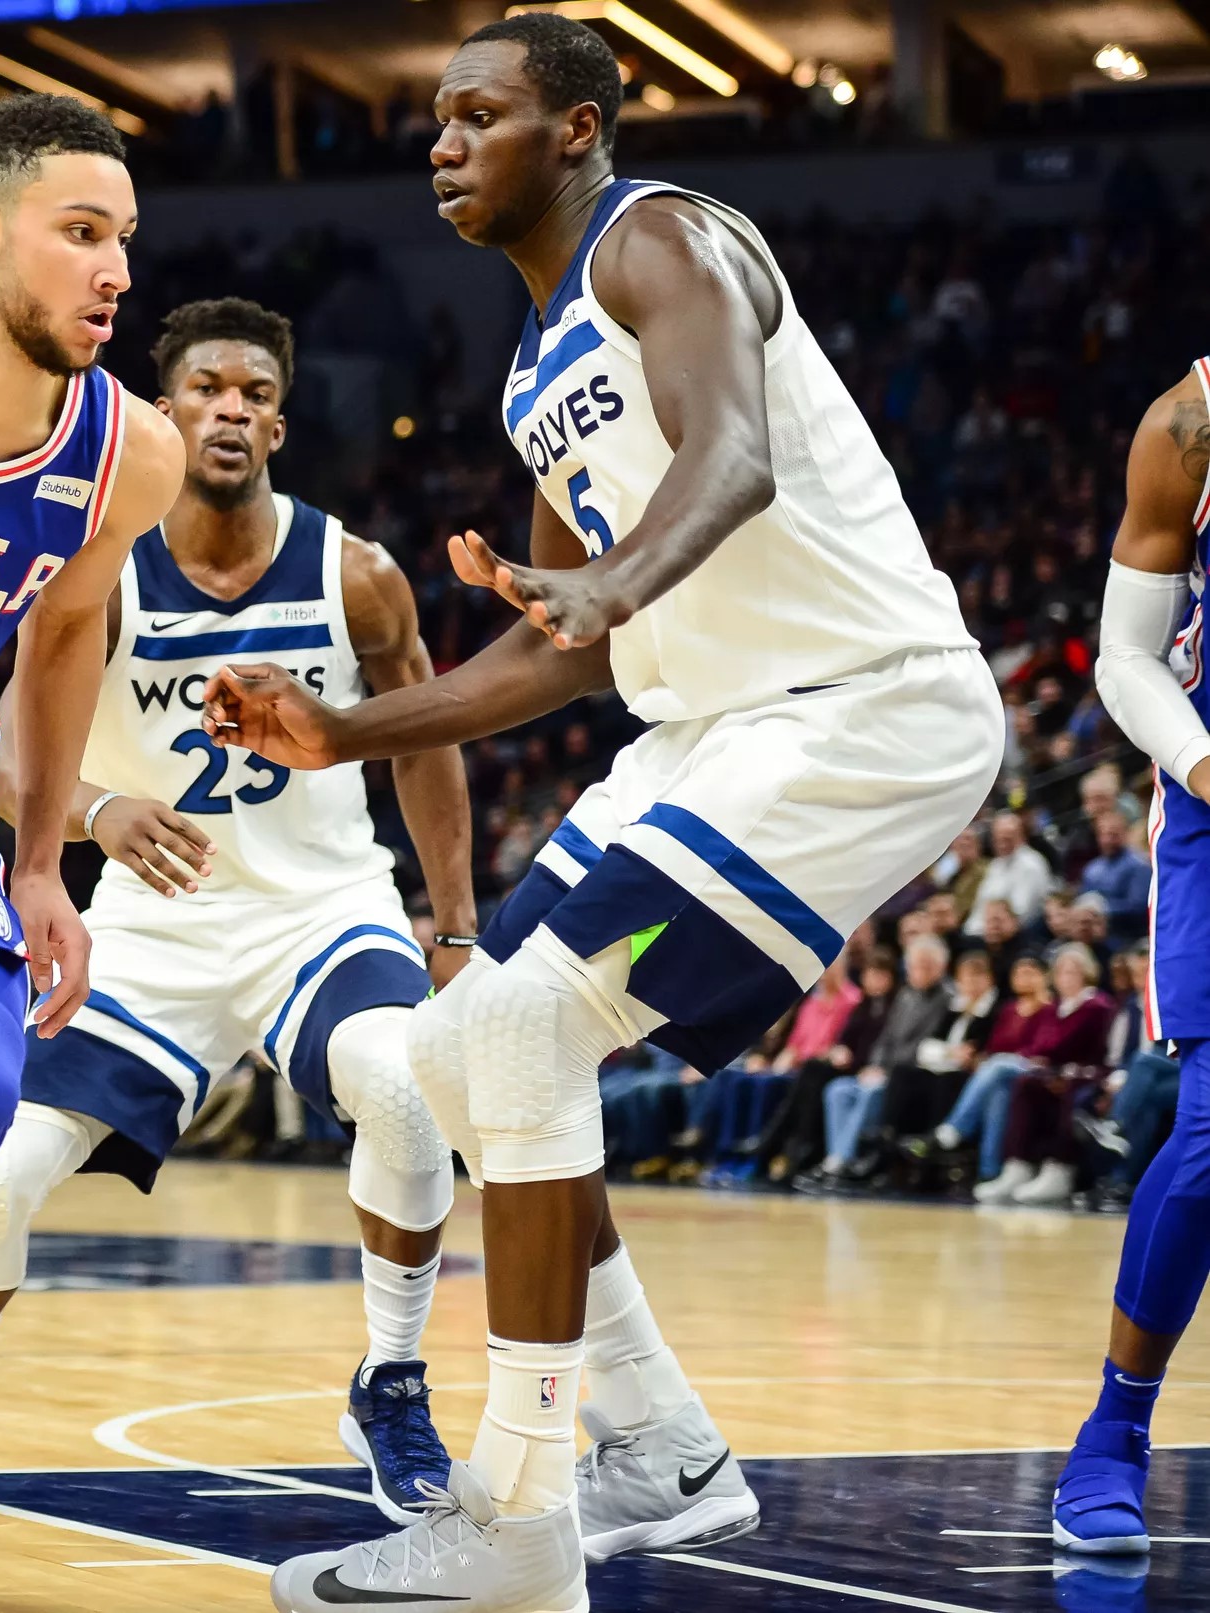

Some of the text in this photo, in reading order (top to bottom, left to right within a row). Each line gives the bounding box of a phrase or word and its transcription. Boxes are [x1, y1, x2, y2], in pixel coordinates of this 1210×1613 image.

[41, 481, 82, 498] StubHub
[567, 466, 615, 560] 5
[285, 607, 317, 621] fitbit
